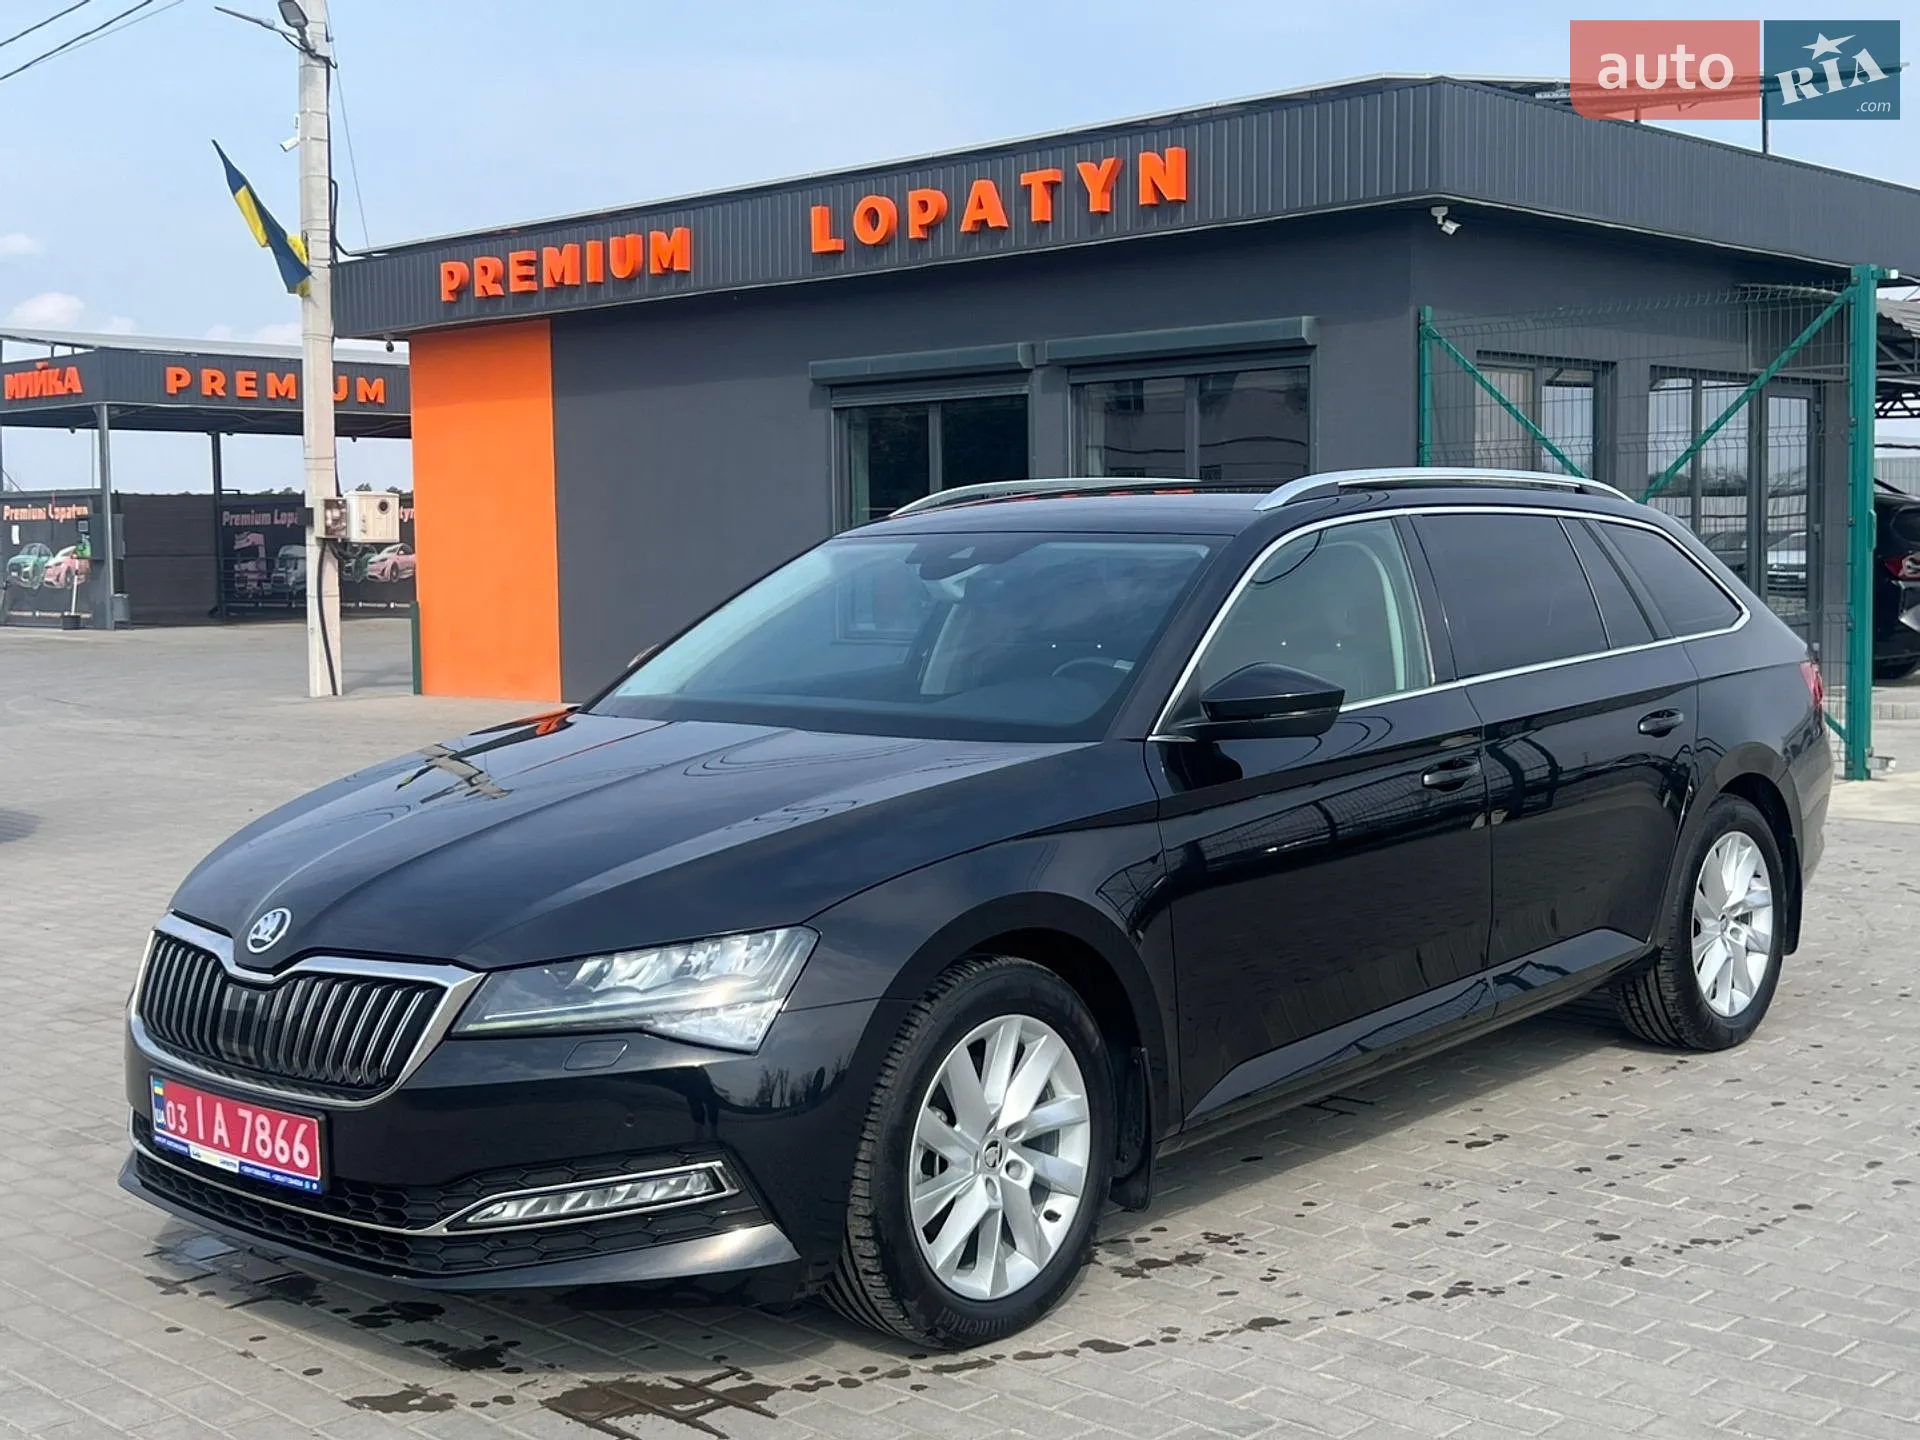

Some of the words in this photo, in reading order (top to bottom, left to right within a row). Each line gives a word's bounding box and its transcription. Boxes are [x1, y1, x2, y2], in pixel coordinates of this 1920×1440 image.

[440, 226, 691, 302] PREMIUM
[810, 146, 1187, 254] LOPATYN
[165, 366, 385, 404] PREMUM
[166, 1100, 188, 1135] 03
[237, 1108, 310, 1169] 7866
